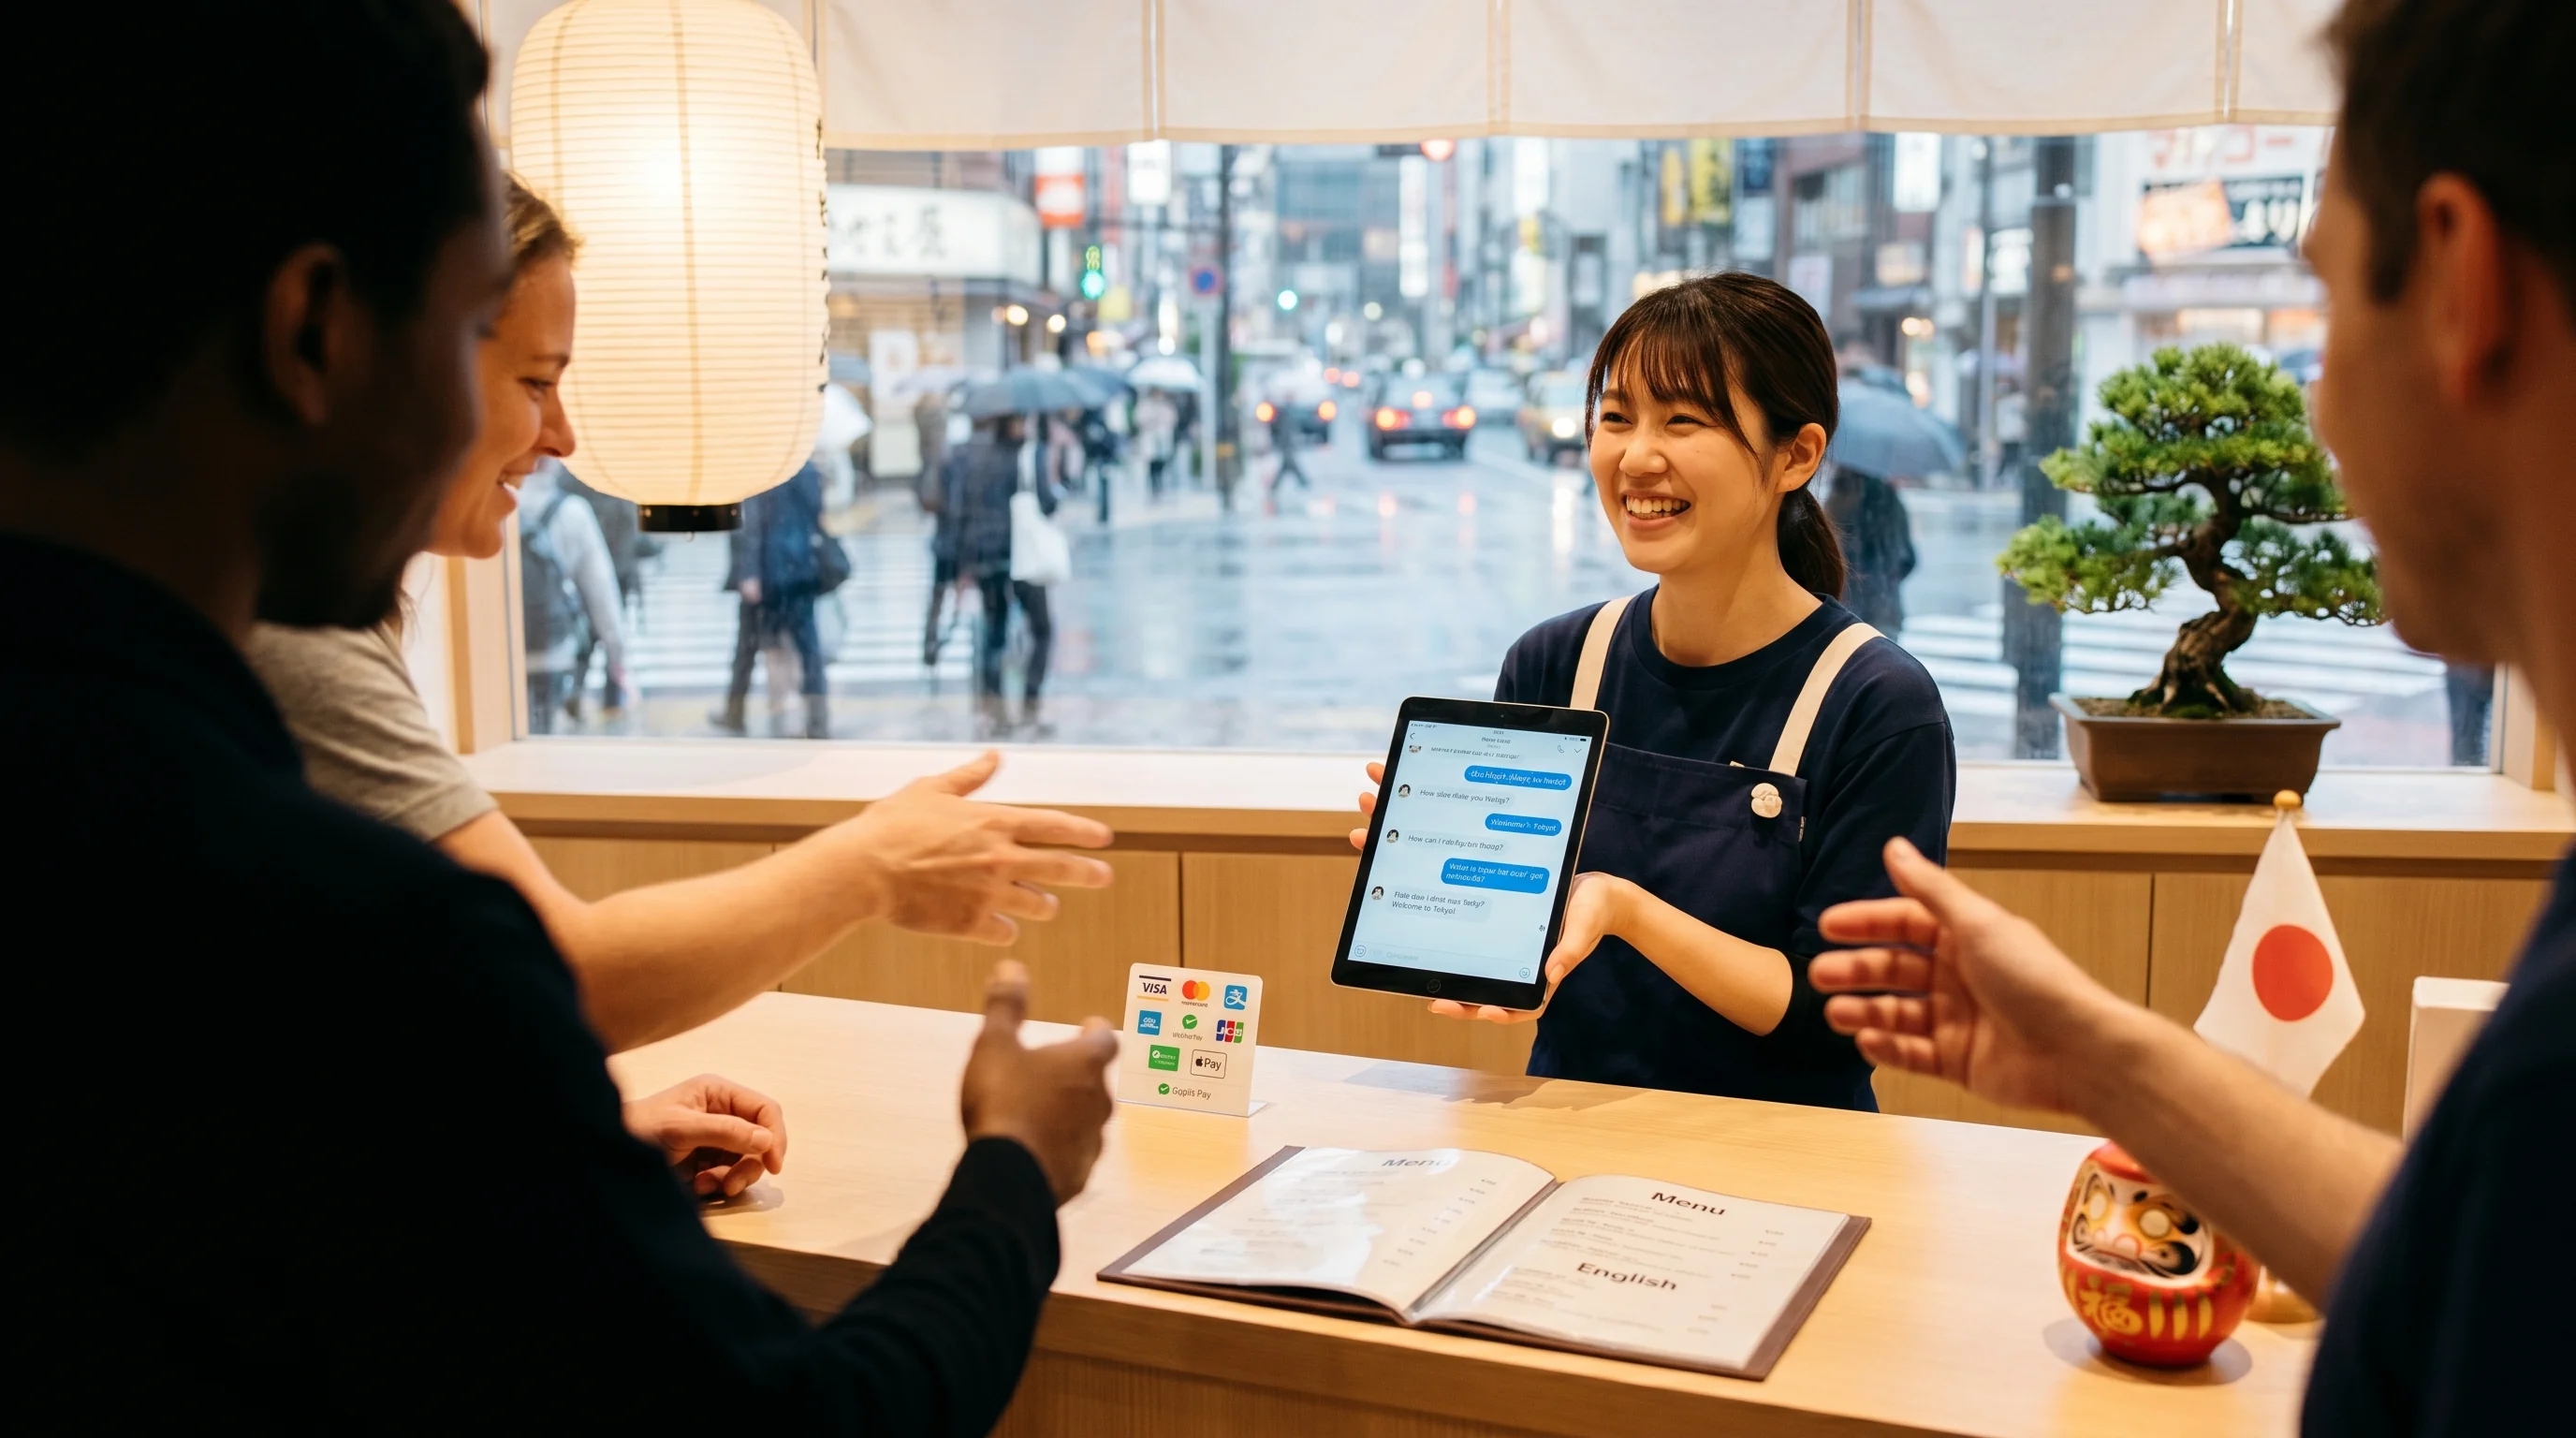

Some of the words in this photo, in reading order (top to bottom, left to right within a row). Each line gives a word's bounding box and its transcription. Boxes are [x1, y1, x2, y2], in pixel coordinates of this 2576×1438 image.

[1408, 834, 1423, 843] How
[1392, 901, 1422, 911] Welcome
[1142, 982, 1167, 995] VISA
[1204, 1058, 1222, 1071] Pay
[1196, 1089, 1212, 1101] Pay
[1650, 1191, 1726, 1217] Menu
[1575, 1261, 1678, 1292] English
